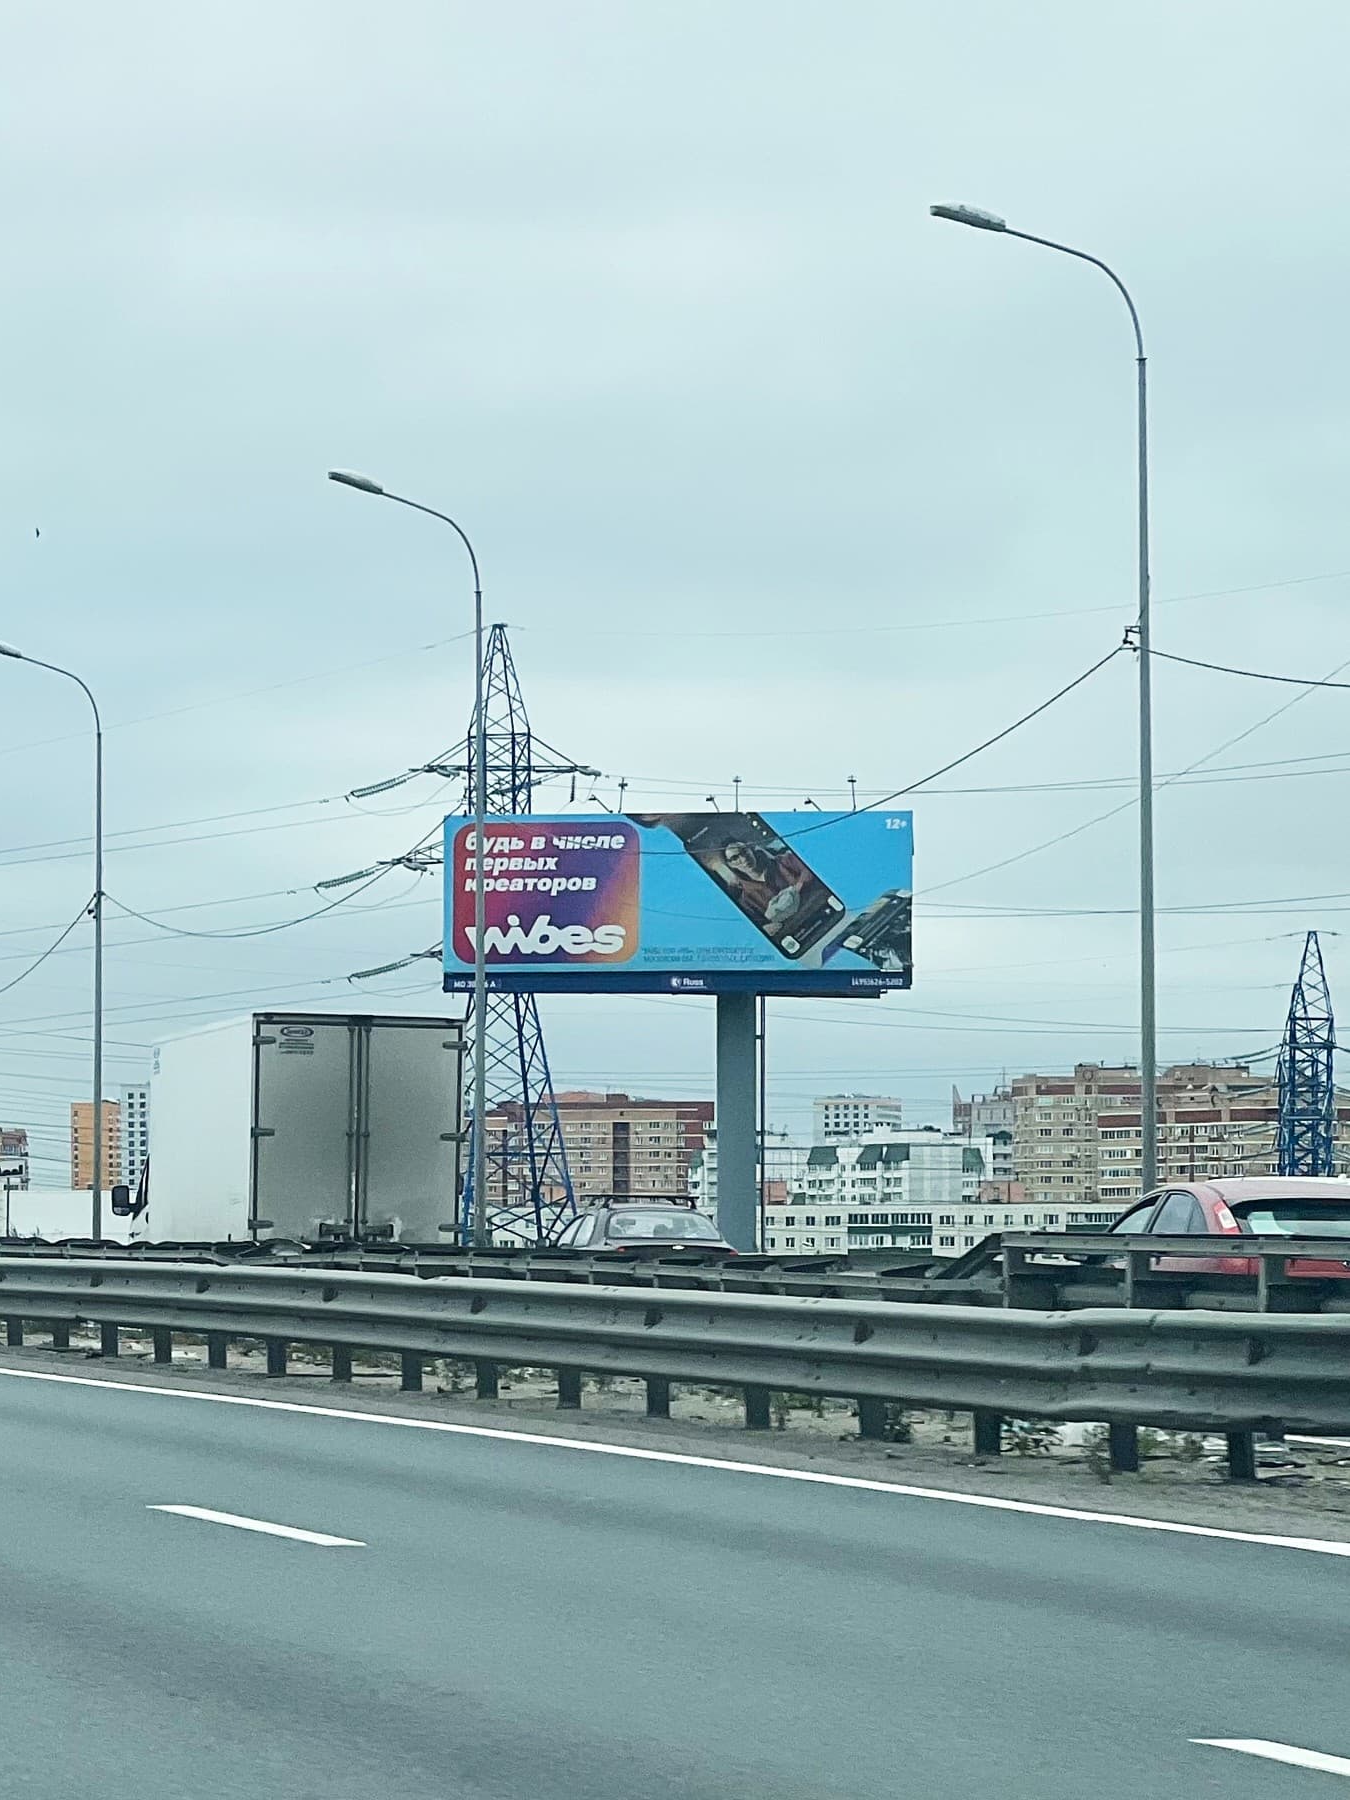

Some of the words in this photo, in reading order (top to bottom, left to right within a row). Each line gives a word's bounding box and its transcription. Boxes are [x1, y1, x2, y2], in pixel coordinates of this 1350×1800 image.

[885, 818, 907, 830] 12+
[465, 832, 524, 855] будь
[530, 836, 546, 850] в
[552, 834, 625, 850] числе
[465, 857, 558, 875] первых
[465, 877, 597, 896] креаторов
